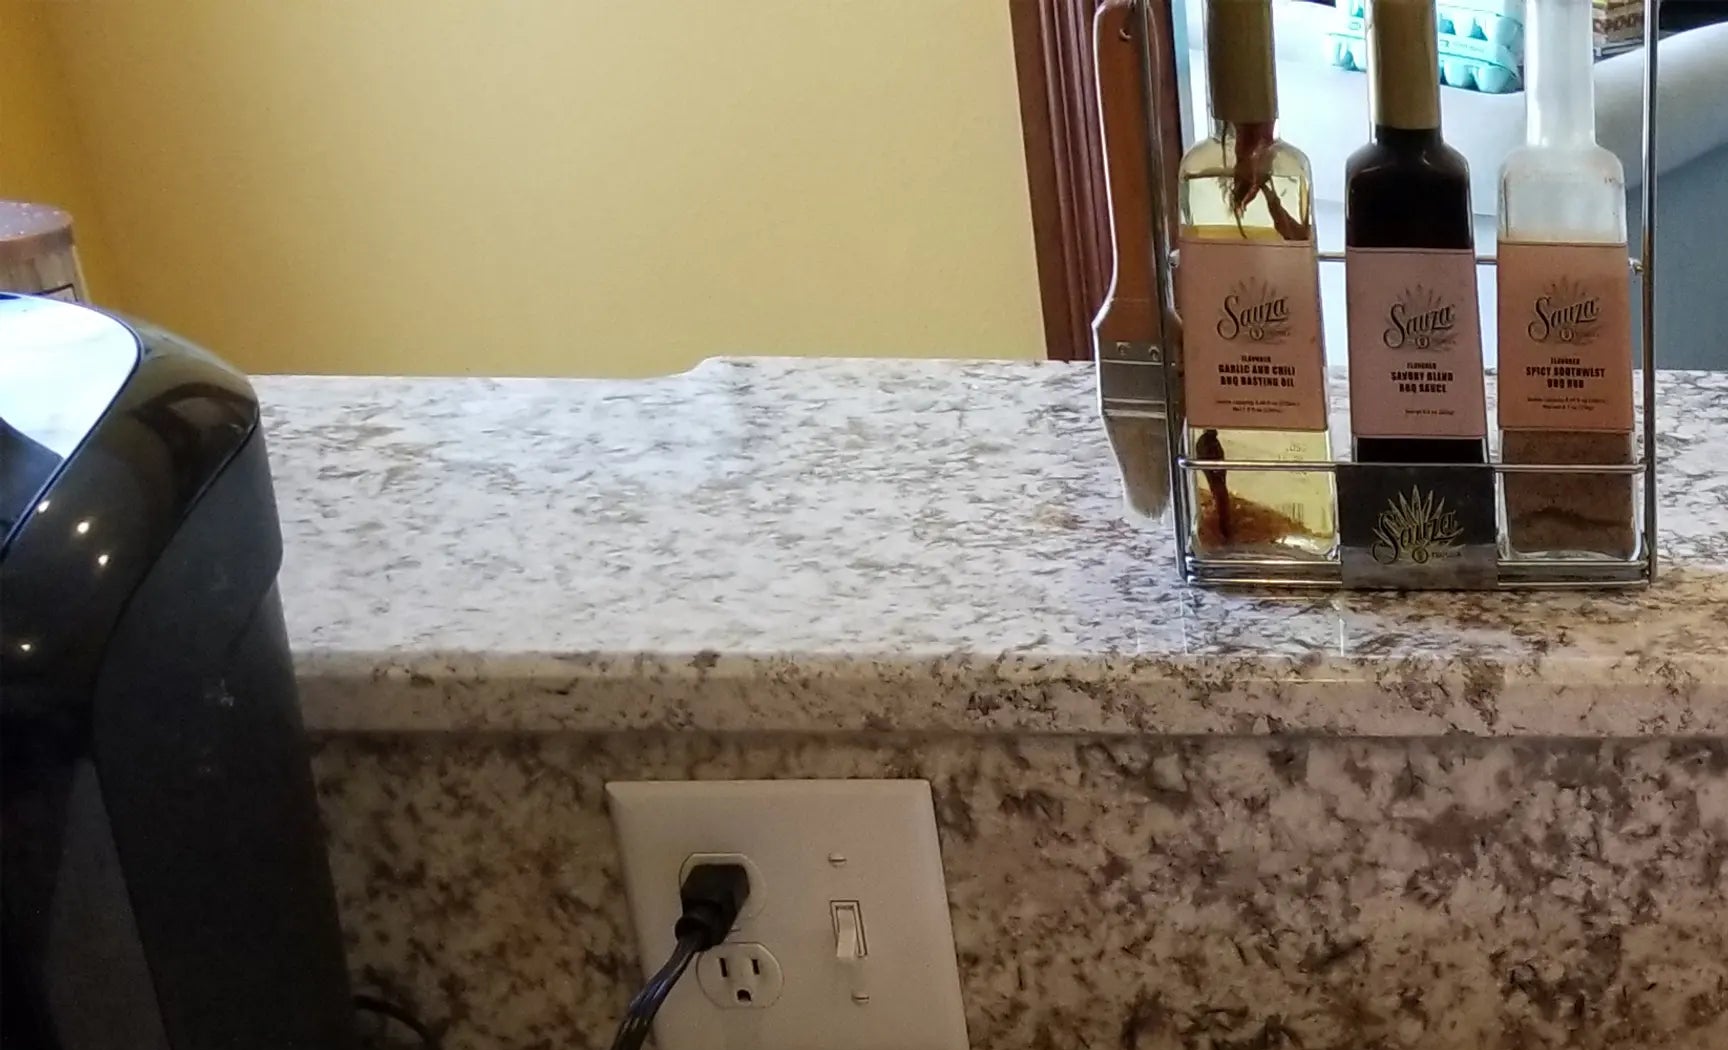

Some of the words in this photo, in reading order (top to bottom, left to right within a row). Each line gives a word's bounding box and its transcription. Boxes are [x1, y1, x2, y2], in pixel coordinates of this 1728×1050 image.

[1217, 295, 1290, 341] Sauza
[1528, 296, 1600, 342] Sauza
[1383, 303, 1456, 349] Sauza
[1218, 364, 1250, 374] GARLIC
[1252, 364, 1270, 375] AND
[1272, 366, 1296, 377] CHILI
[1391, 371, 1424, 381] SAVORY
[1526, 366, 1551, 377] SPICY
[1553, 366, 1606, 378] SOUTHWEST
[1220, 375, 1239, 386] BBQ
[1241, 376, 1279, 387] BASTING
[1281, 377, 1295, 388] OIL
[1399, 383, 1417, 393] BBQ
[1419, 383, 1447, 393] SAUCE
[1547, 378, 1565, 389] BBQ
[1372, 510, 1459, 565] Sauza
